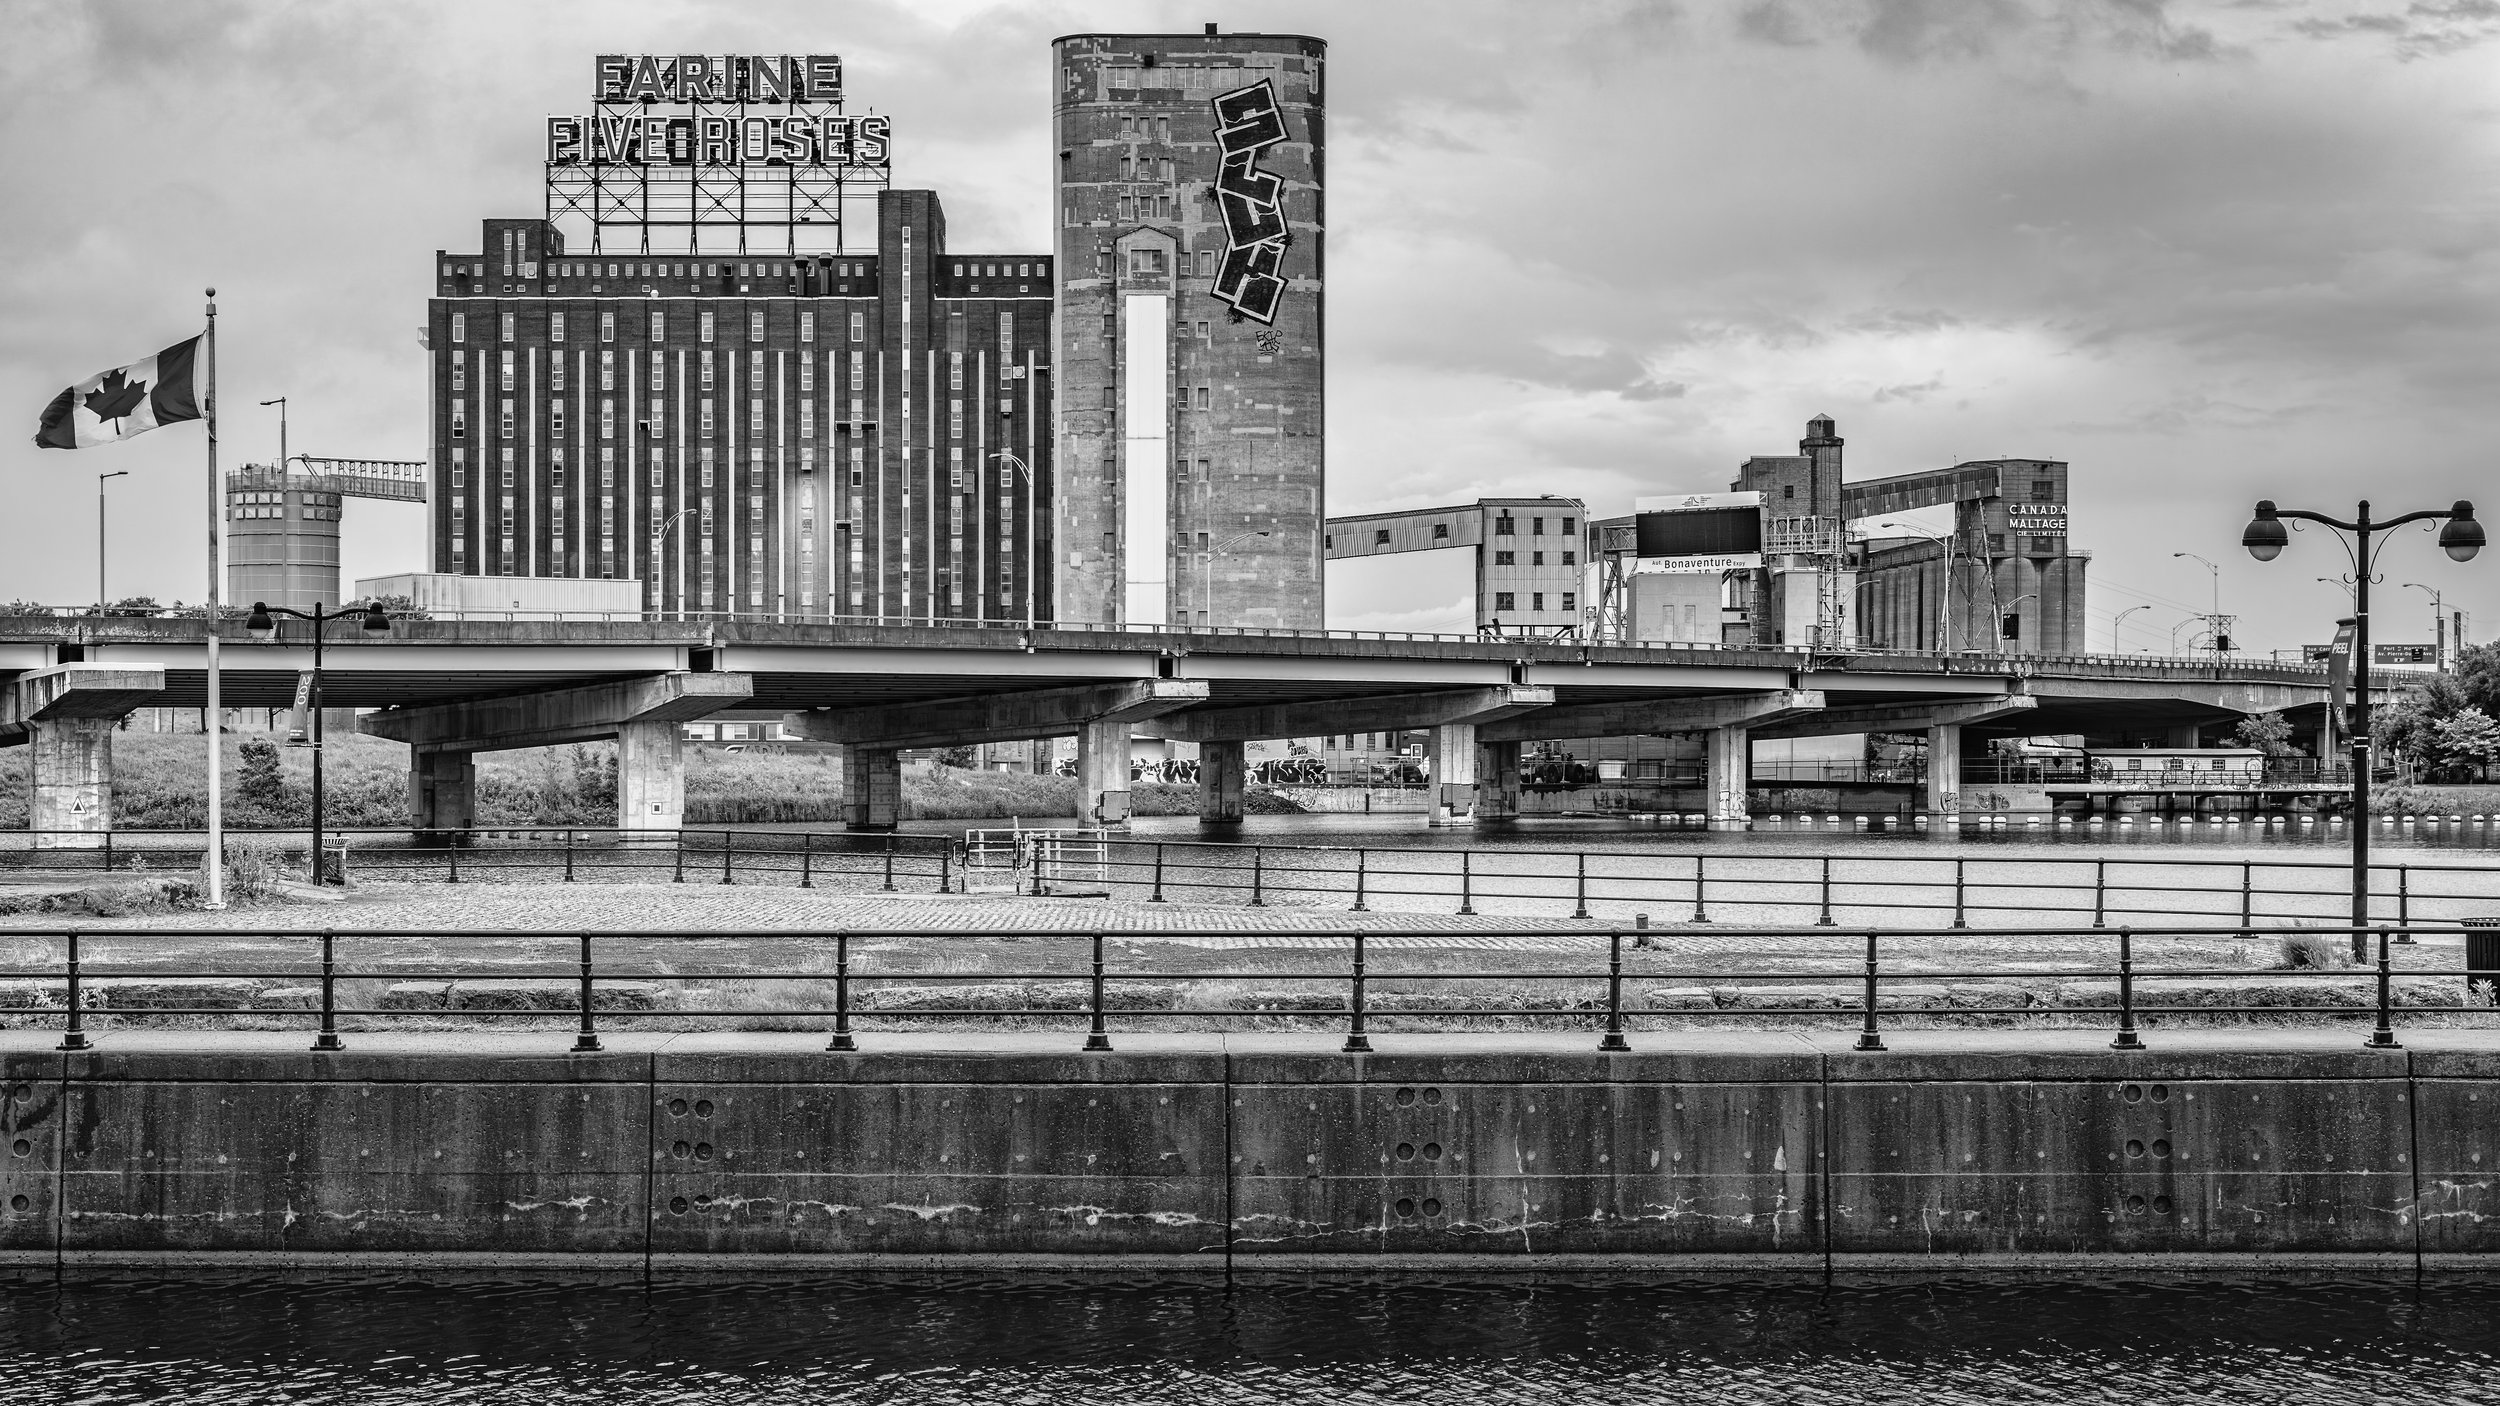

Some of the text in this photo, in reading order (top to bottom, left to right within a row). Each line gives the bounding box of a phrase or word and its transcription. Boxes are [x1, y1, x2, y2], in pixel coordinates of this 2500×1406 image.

[594, 54, 842, 99] FARINE
[547, 115, 891, 164] FIVE ROSES
[2009, 504, 2068, 515] CANADA
[2009, 518, 2066, 529] MALTAGE
[1664, 557, 1732, 569] Bonaventure
[2332, 642, 2349, 655] PEEL
